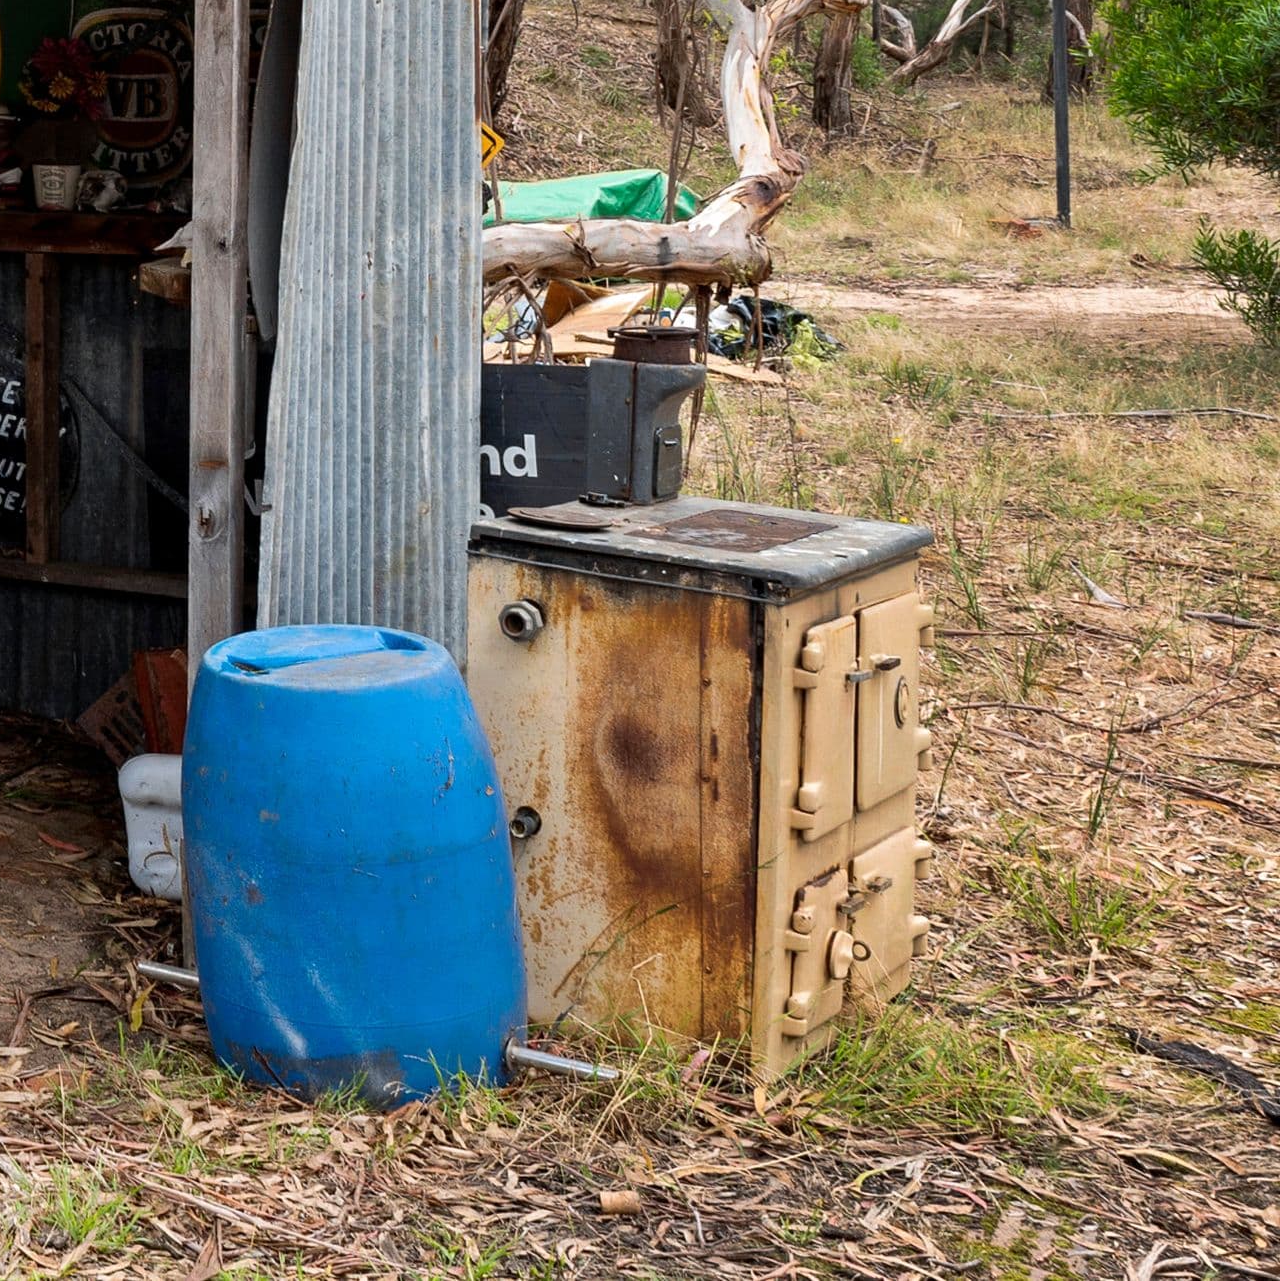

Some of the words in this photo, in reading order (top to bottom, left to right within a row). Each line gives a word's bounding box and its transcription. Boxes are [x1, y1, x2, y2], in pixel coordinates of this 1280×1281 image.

[89, 22, 192, 84] CTORIA
[108, 79, 162, 119] VB
[91, 126, 192, 174] ITTER
